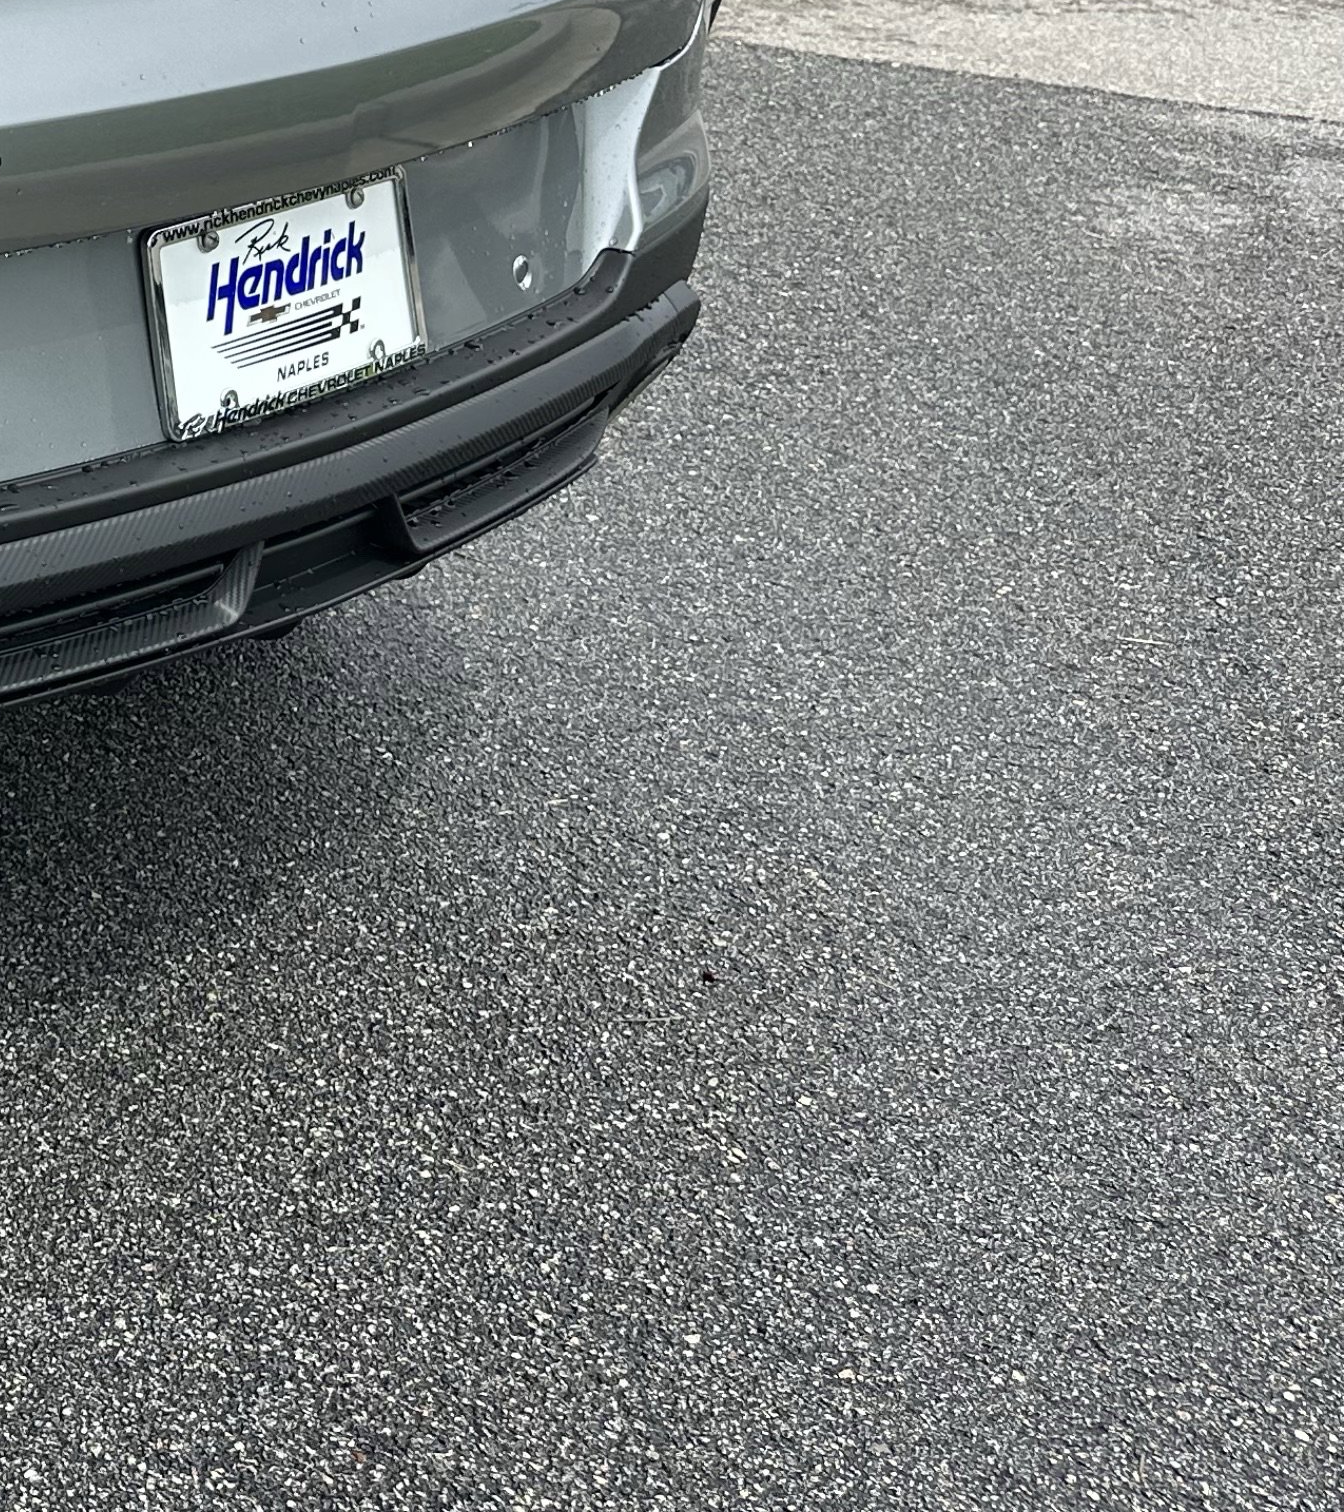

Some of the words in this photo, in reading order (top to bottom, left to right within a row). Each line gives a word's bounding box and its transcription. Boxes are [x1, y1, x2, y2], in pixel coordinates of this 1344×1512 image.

[206, 220, 366, 335] Hendrick
[294, 289, 341, 311] CHEVROLET
[213, 390, 287, 433] Hendrick
[287, 365, 372, 405] CHEVROLET
[374, 343, 426, 374] NAPLES
[277, 351, 330, 383] NAPLES
